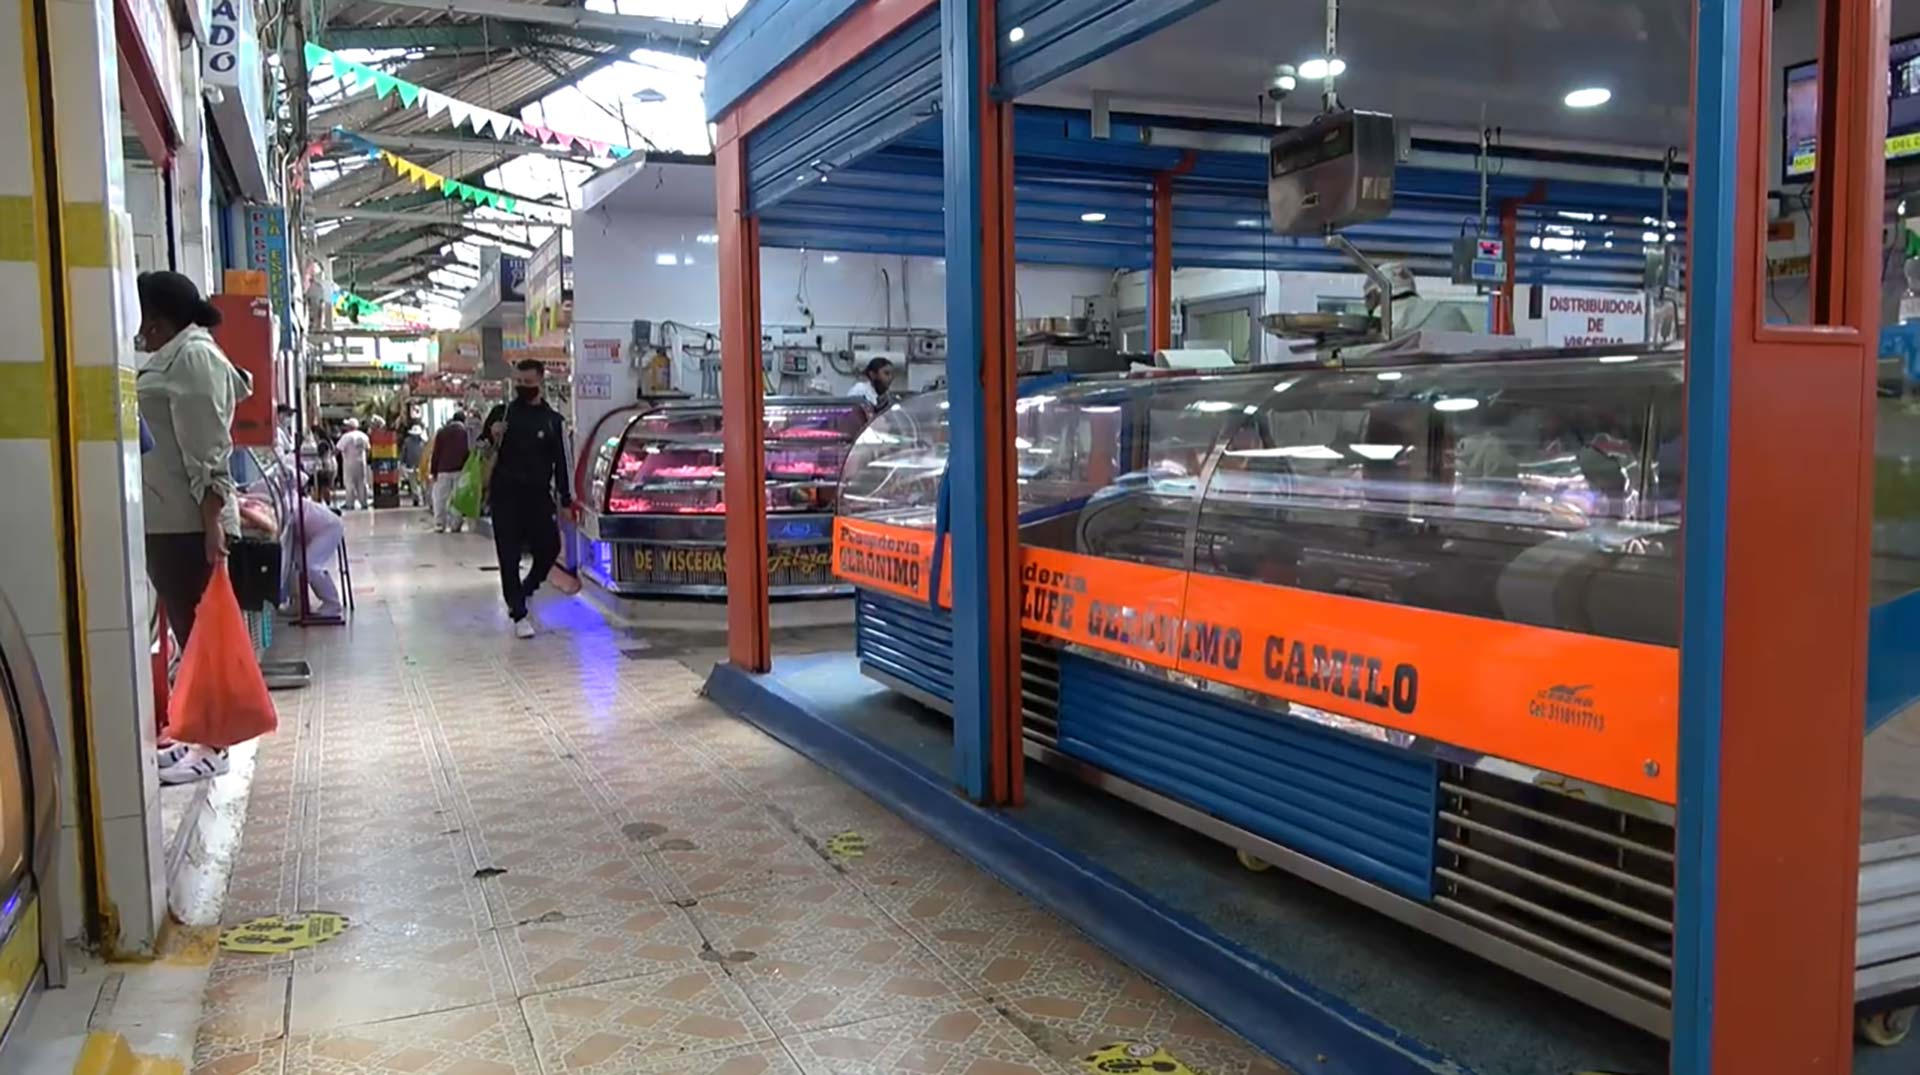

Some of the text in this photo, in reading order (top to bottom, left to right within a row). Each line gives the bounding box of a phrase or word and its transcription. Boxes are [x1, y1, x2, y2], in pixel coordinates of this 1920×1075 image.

[253, 212, 266, 272] PESC
[1550, 296, 1643, 315] DISTRIBUIDORA
[1587, 318, 1604, 333] DE
[634, 550, 653, 570] DE
[1264, 635, 1418, 714] CAMILO
